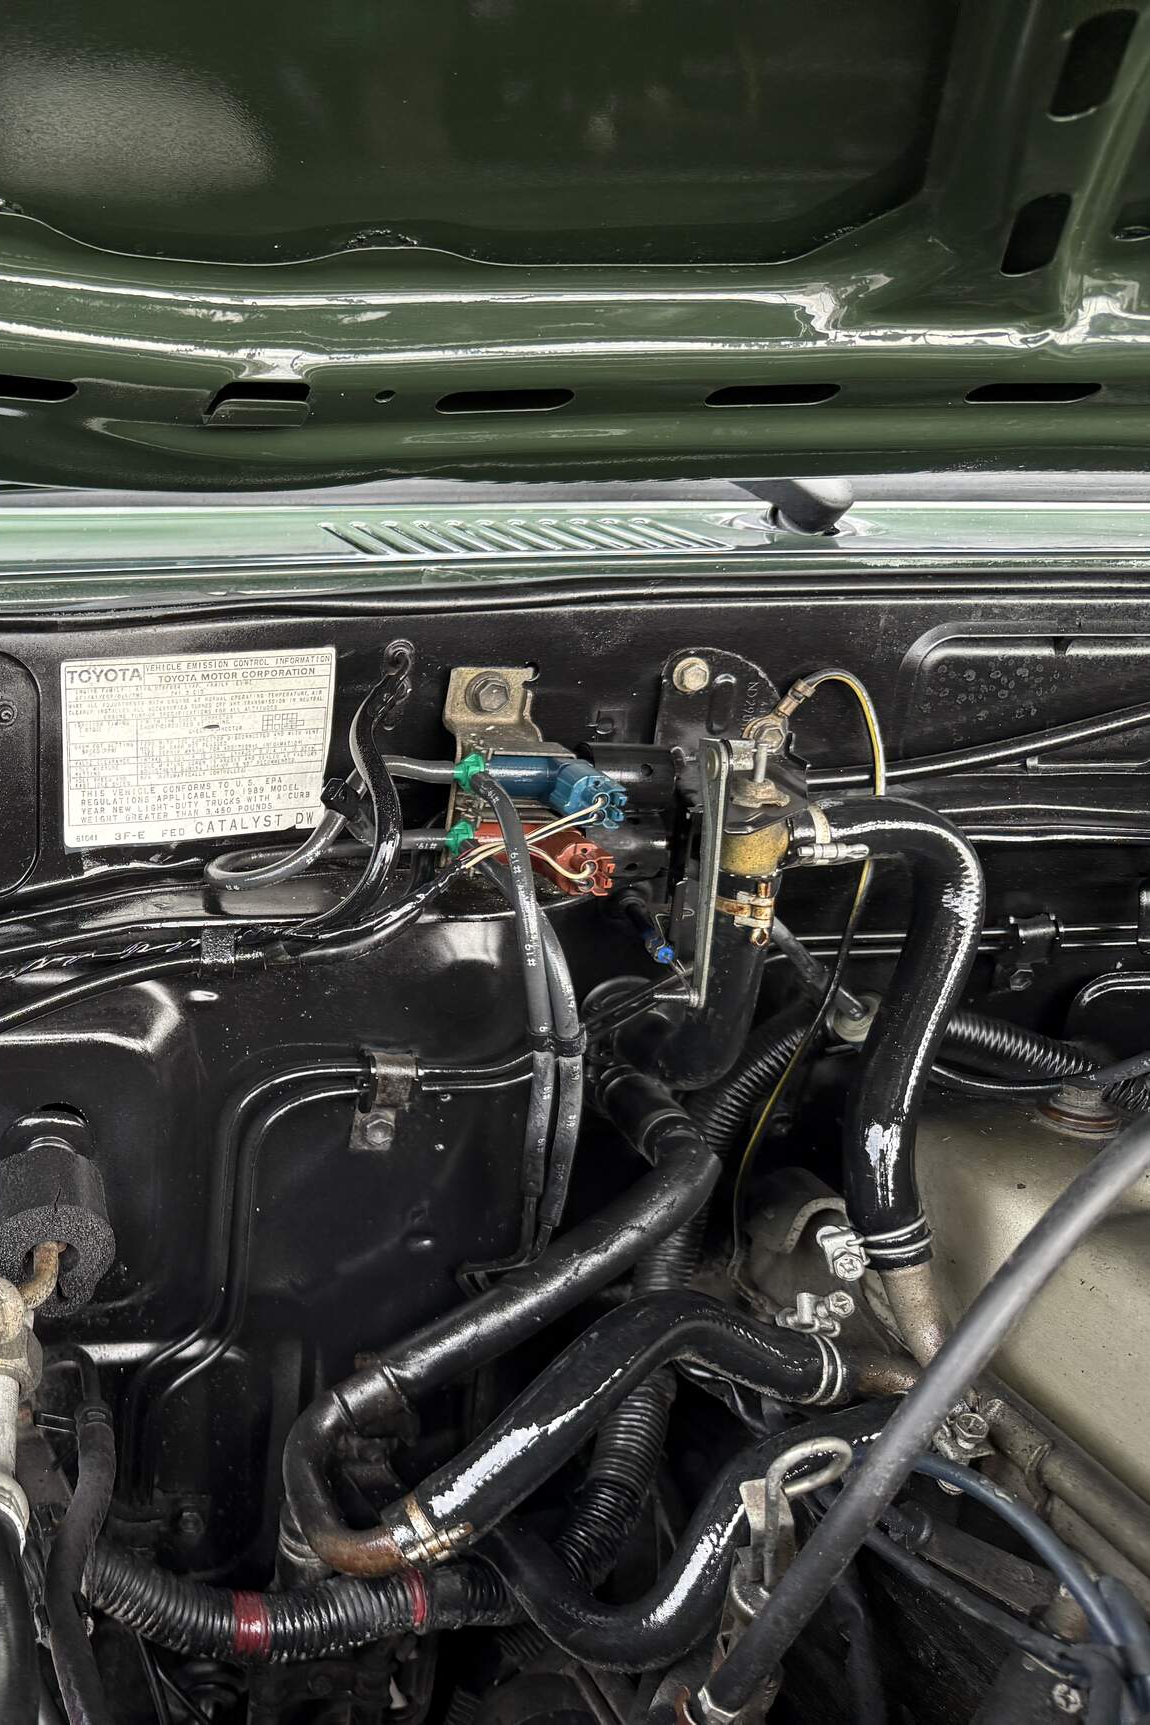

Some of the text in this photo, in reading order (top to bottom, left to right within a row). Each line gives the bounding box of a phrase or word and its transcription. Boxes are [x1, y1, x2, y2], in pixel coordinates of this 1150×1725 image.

[145, 655, 330, 671] VEHICLE EMISSION CONTROL INFORMATION
[66, 666, 142, 684] TOYOTA
[158, 667, 315, 682] TOYOTA MOTOR CORPORATION
[80, 789, 105, 798] THIS
[112, 786, 155, 796] VEHICLE
[162, 782, 211, 793] CONFORMS
[217, 780, 229, 789] TO
[265, 776, 282, 784] EPA
[80, 783, 298, 807] REGULATIONS APPLICABLE TO 1989 MODEL
[81, 806, 105, 815] YEAR
[112, 804, 131, 813] NEW
[137, 800, 198, 812] LIGHT-DUTY
[204, 796, 240, 806] TRUCKS
[246, 794, 269, 803] WITH
[287, 790, 310, 799] CURB
[80, 813, 118, 824] WEIGHT
[125, 810, 168, 821] GREATER
[175, 808, 198, 817] THAN
[205, 806, 231, 816] 3,450
[161, 811, 314, 837] FED CATALYST DW
[114, 830, 145, 841] 3F-E
